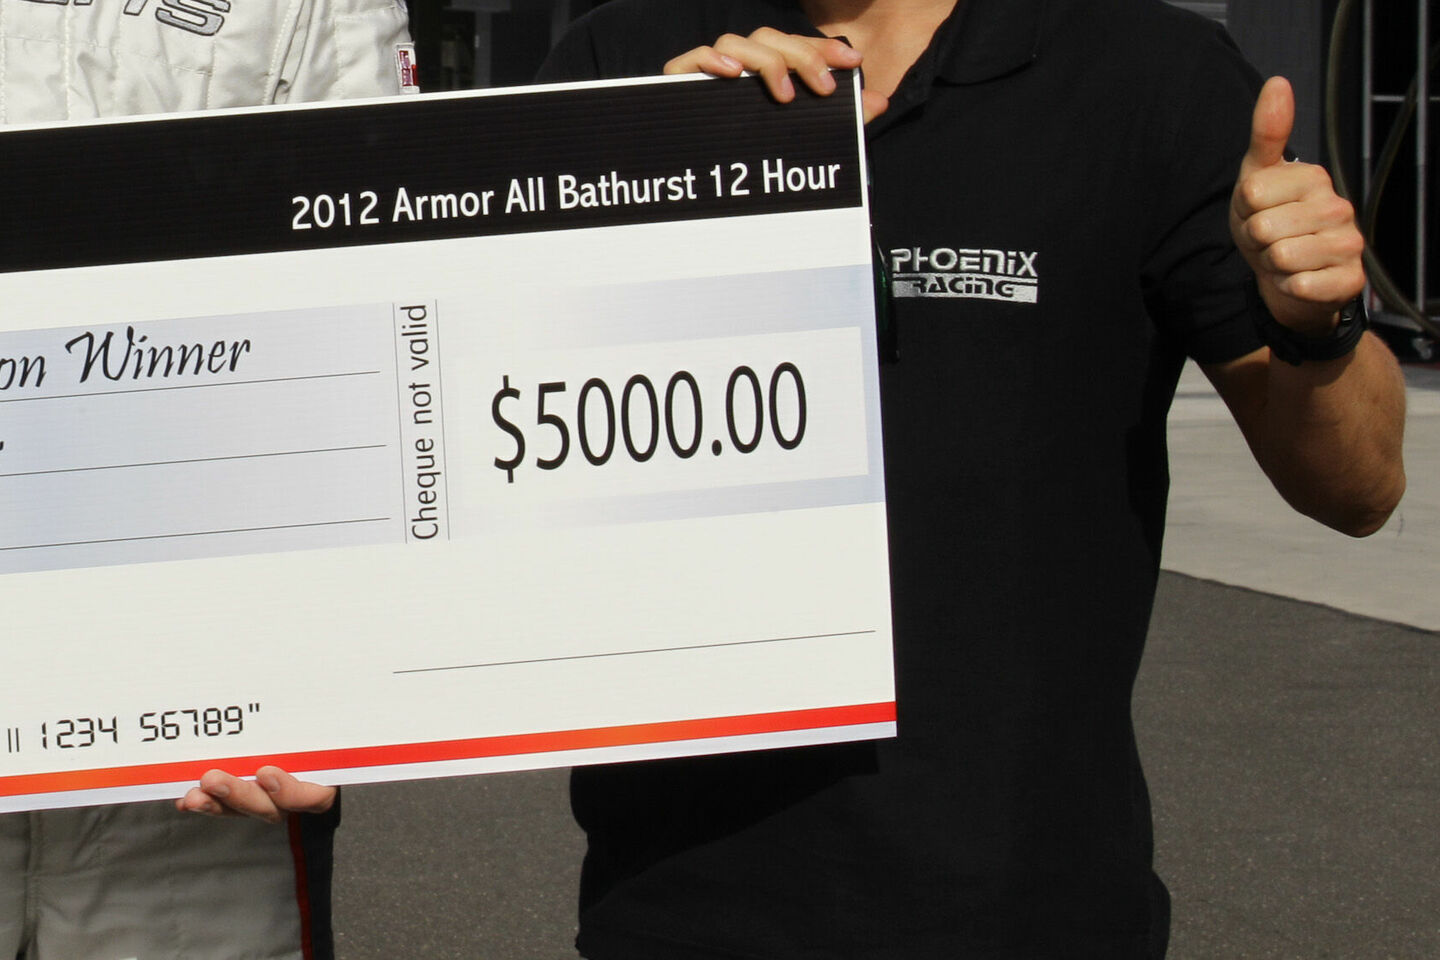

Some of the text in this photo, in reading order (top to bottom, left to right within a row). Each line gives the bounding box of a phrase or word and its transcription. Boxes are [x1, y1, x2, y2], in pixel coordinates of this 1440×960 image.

[293, 159, 840, 229] 2012 Armor All Bathurst 12 Hour
[65, 326, 250, 383] Winner
[400, 305, 441, 539] Cheque not valid
[492, 362, 806, 483] $5000.00
[42, 717, 117, 749] 1234
